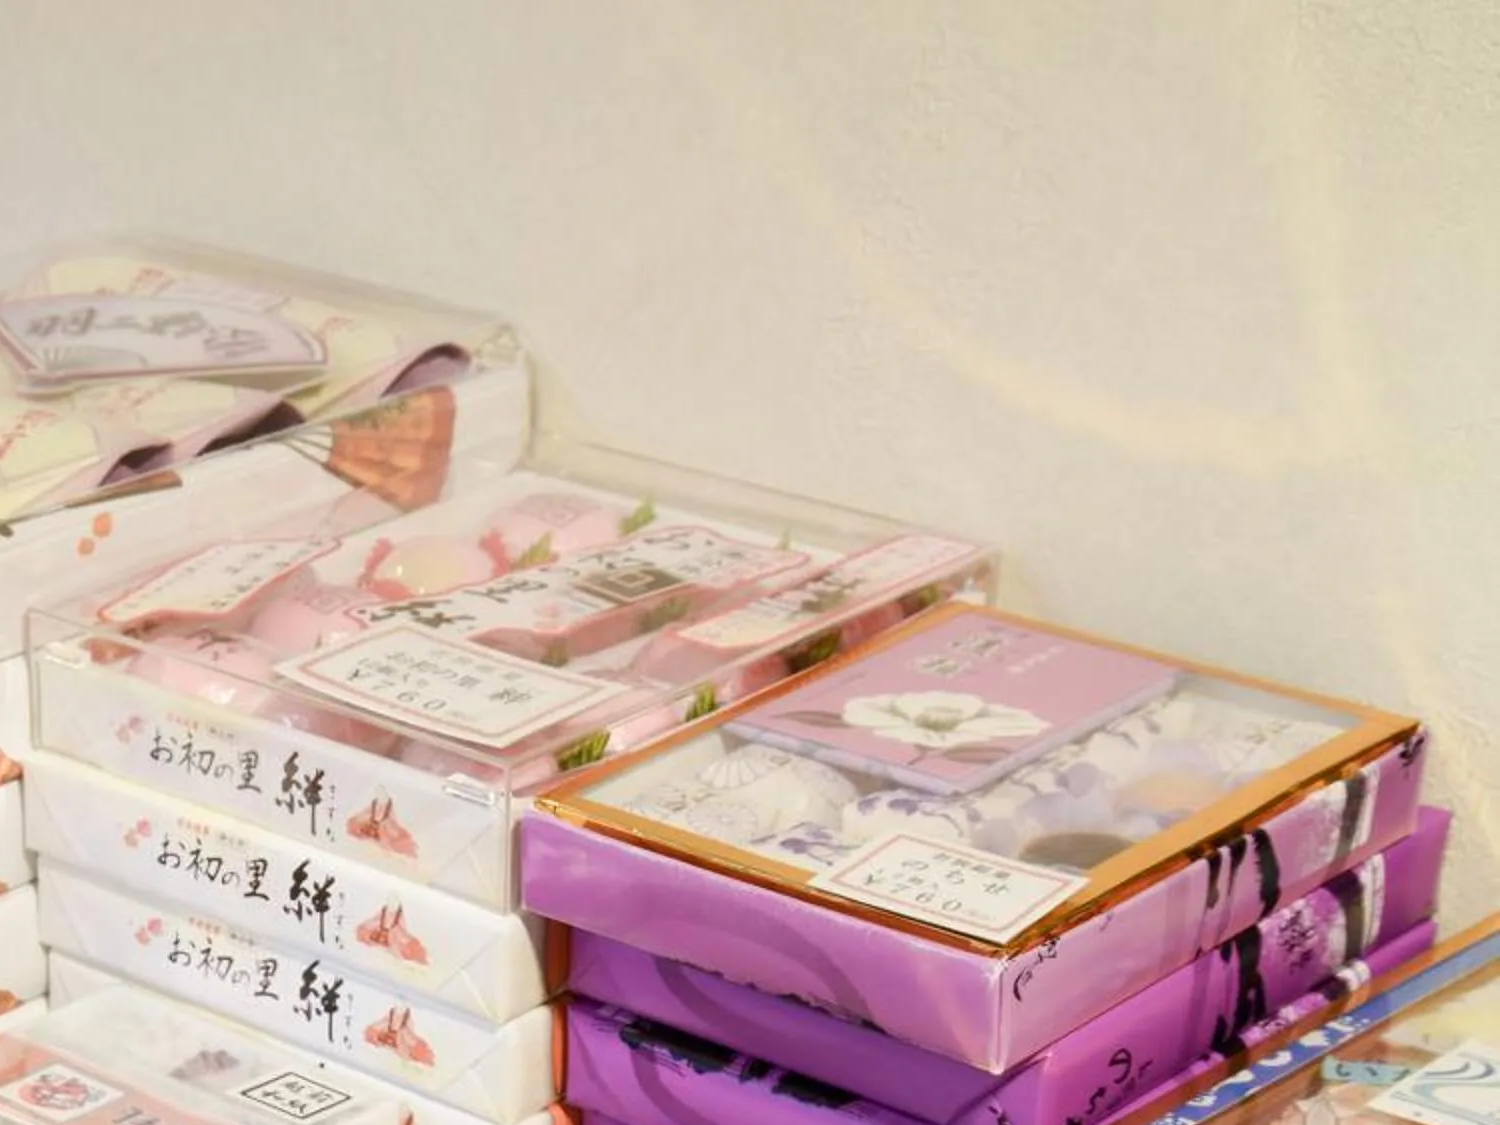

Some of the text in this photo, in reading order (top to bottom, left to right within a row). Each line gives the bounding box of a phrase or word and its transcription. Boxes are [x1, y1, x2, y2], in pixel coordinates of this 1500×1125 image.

[150, 728, 263, 794] お初の里
[157, 833, 271, 902] お初の里
[168, 931, 281, 1000] お初の里
